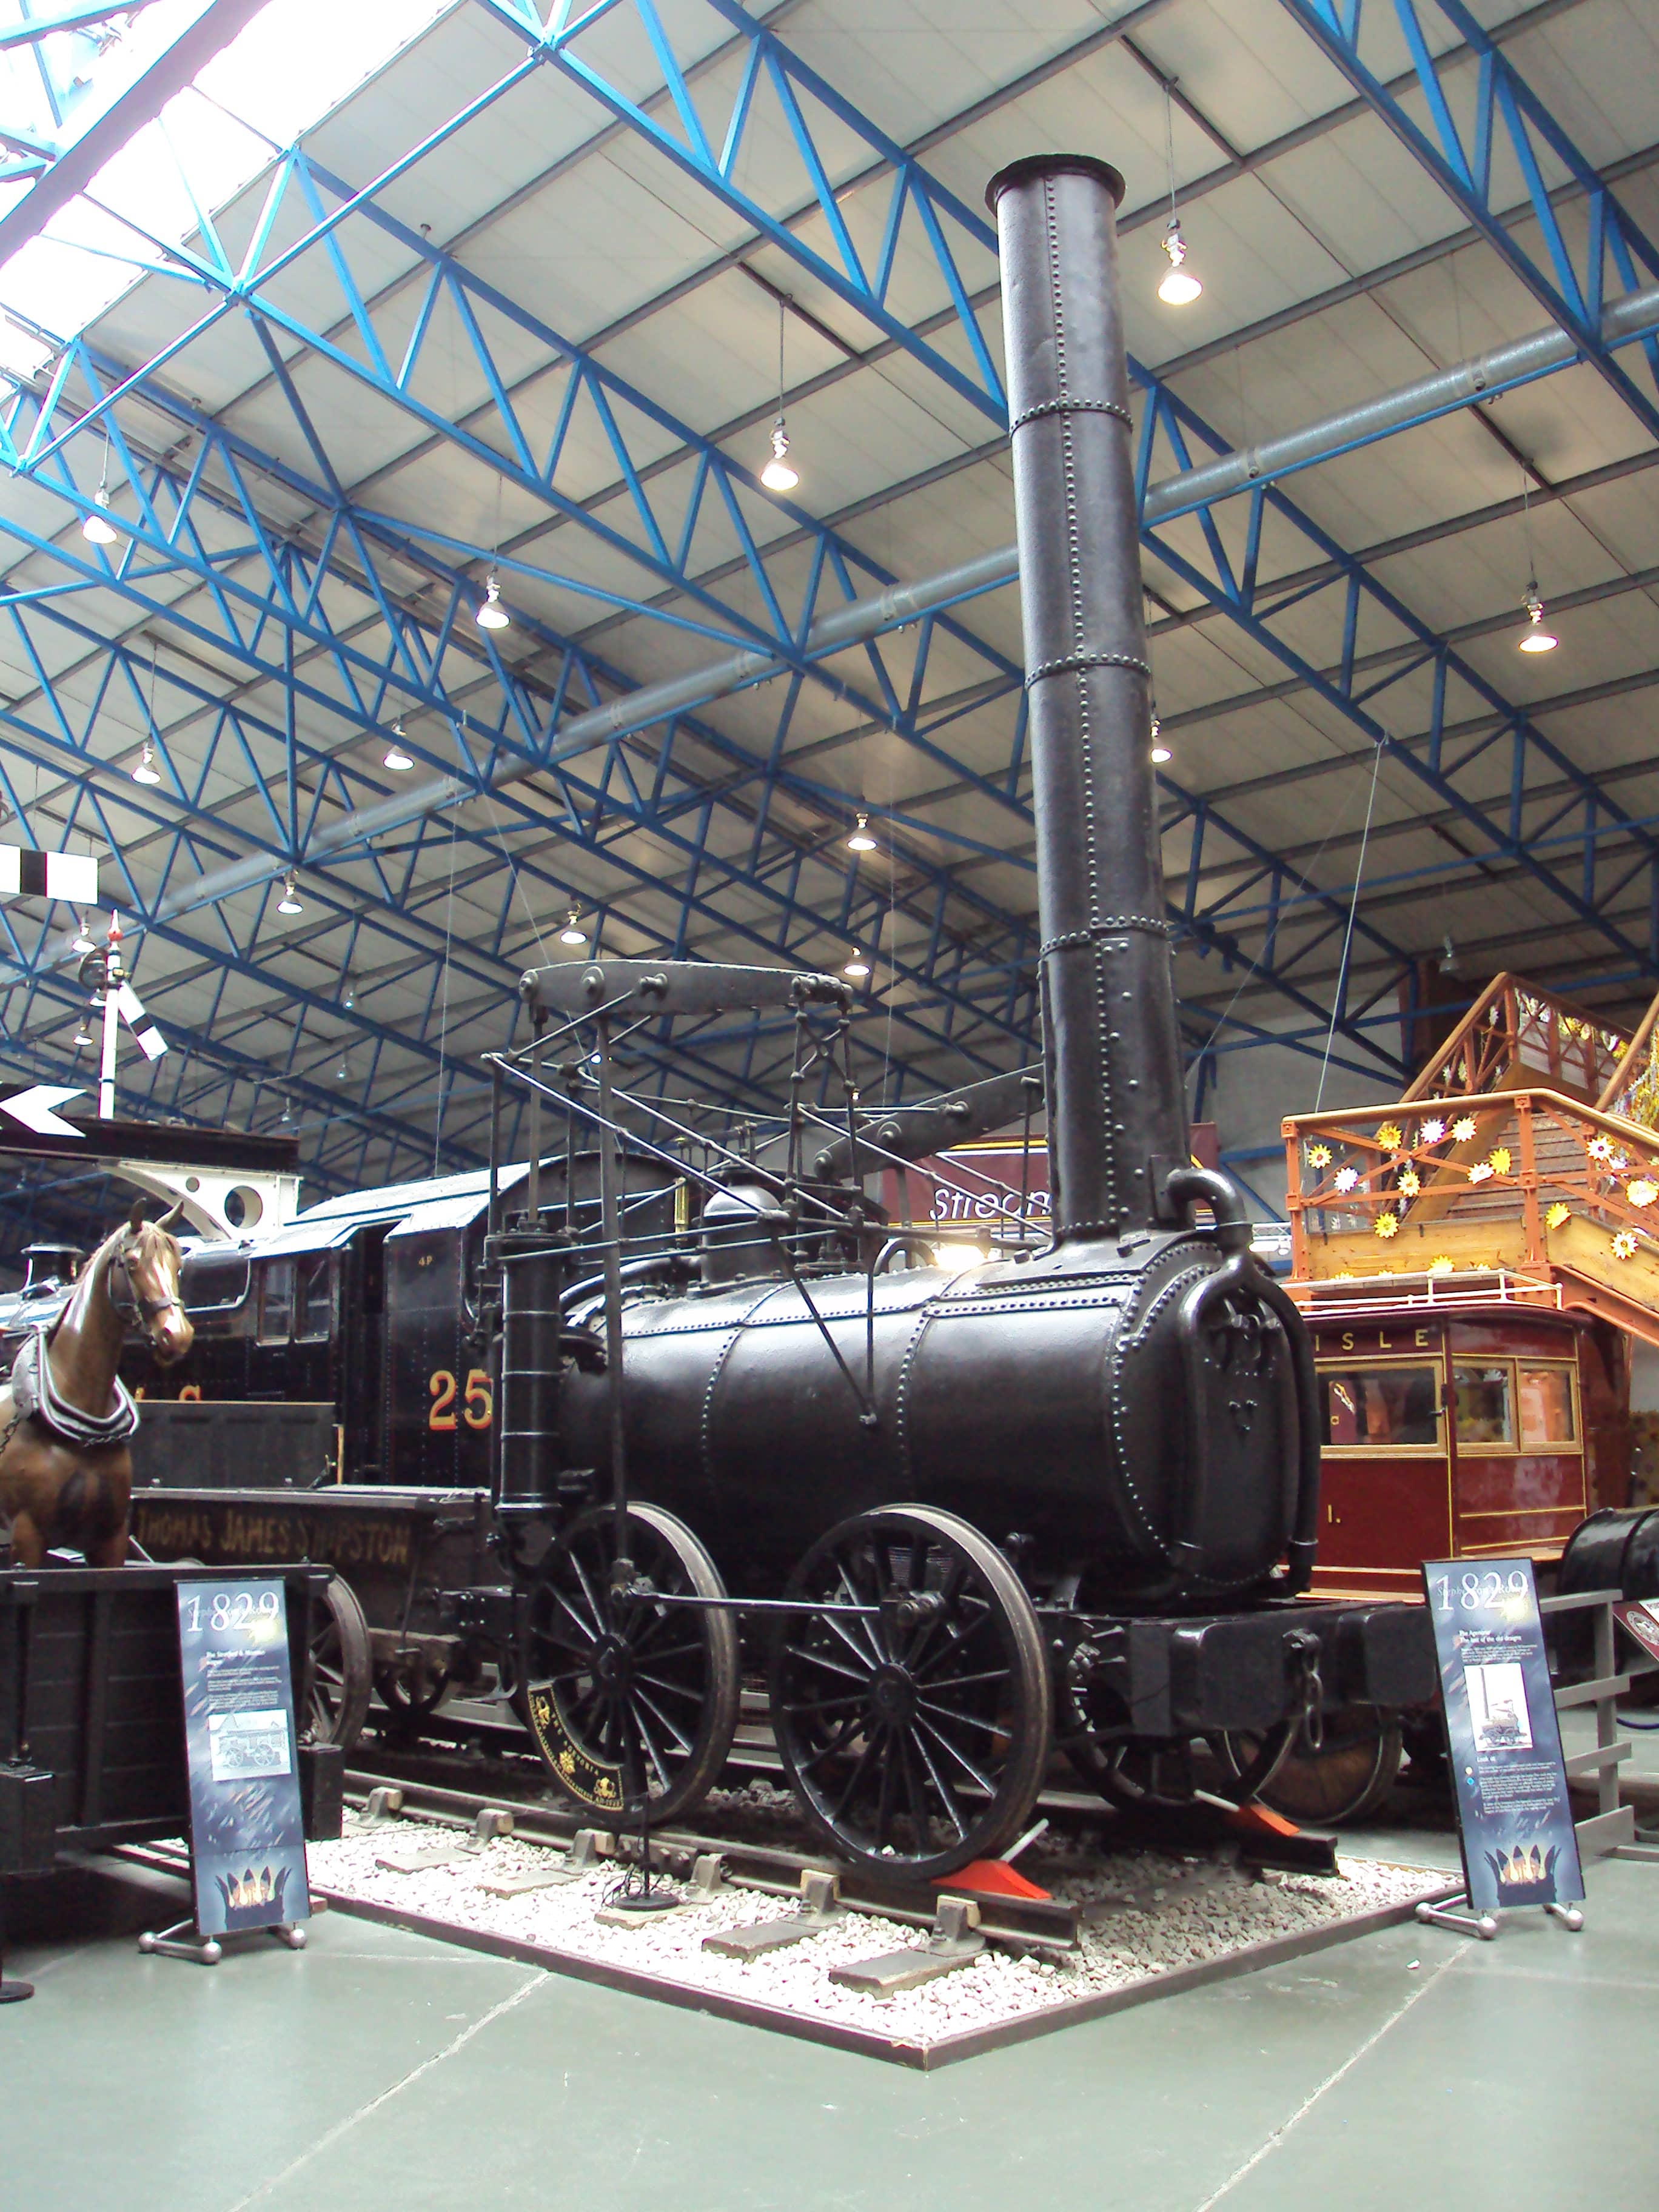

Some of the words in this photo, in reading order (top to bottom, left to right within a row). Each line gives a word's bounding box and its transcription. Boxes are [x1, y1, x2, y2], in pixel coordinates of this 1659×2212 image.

[429, 1369, 492, 1431] 25
[220, 1509, 291, 1555] JAMES
[187, 1591, 279, 1632] 1829
[1436, 1569, 1529, 1611] 1829
